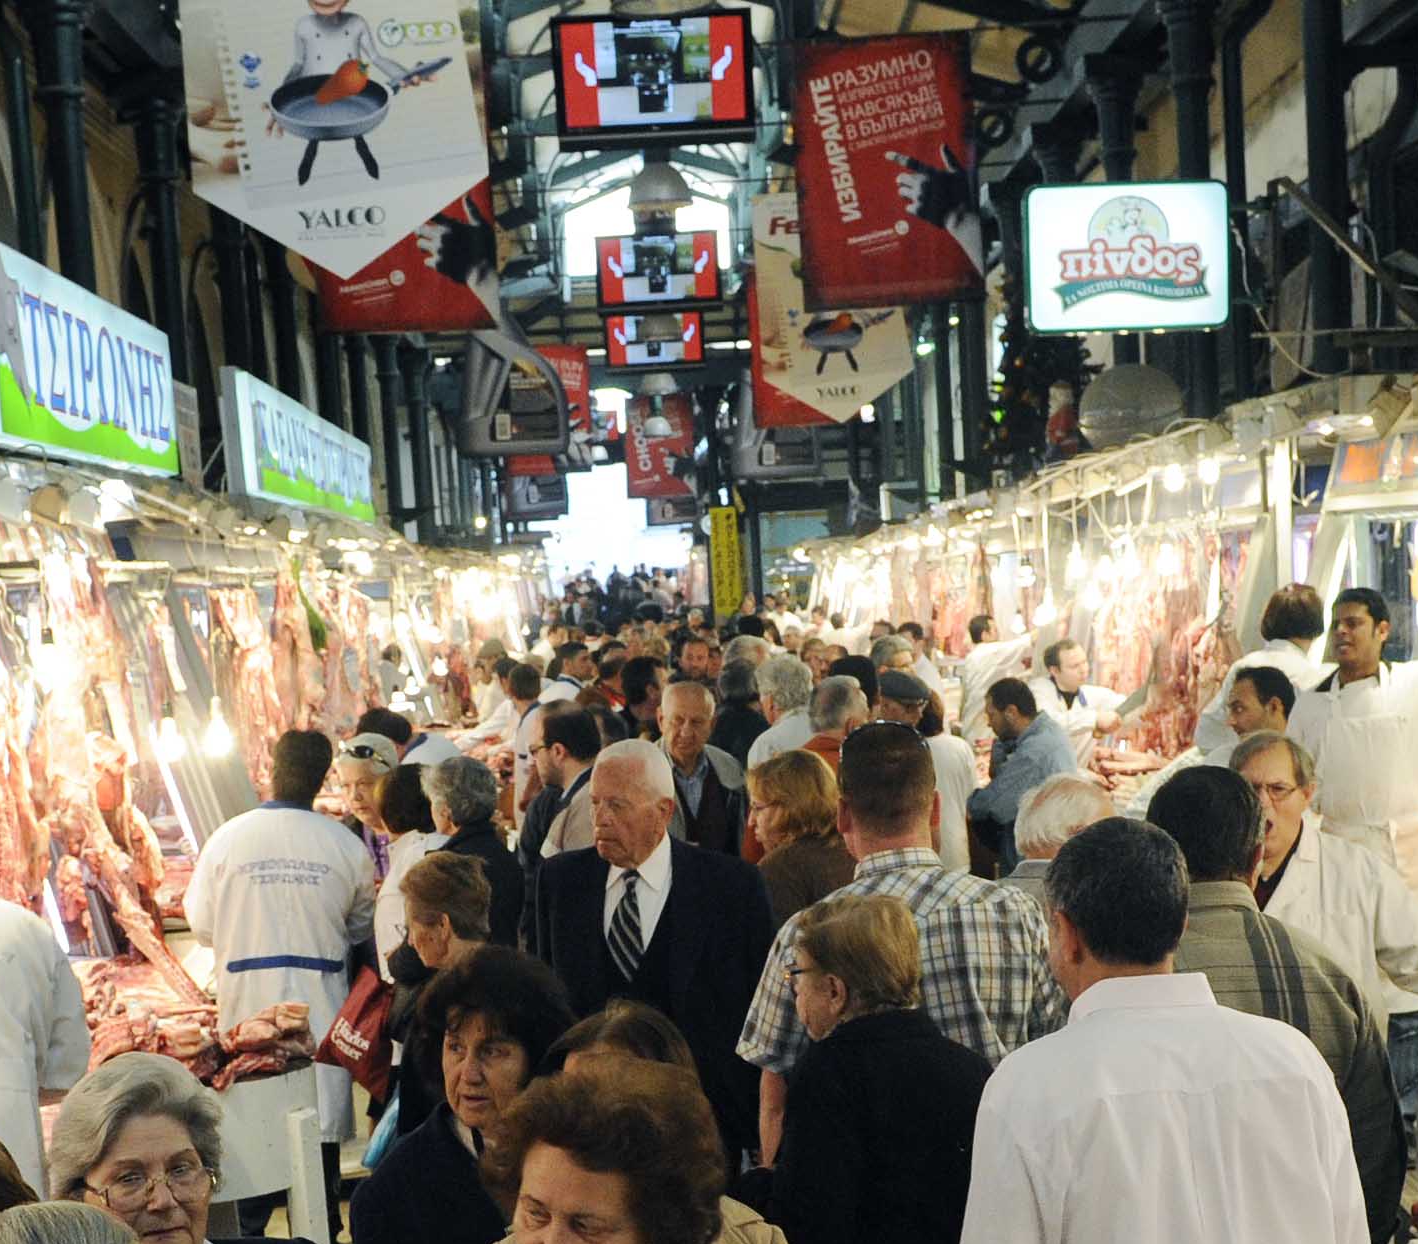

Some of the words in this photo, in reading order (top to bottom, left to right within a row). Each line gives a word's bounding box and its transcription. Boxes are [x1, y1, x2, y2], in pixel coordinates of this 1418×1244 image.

[832, 50, 932, 92] РАЗУМНО
[841, 84, 939, 121] НАВСЯКЪДЕ
[845, 123, 857, 140] В
[859, 101, 943, 137] БЪЛГАРИЯ
[810, 76, 862, 224] ИЗБИРАЙТЕ
[298, 206, 386, 230] YALCO
[21, 288, 171, 442] ΤΣΙΡΩΝΗΣ
